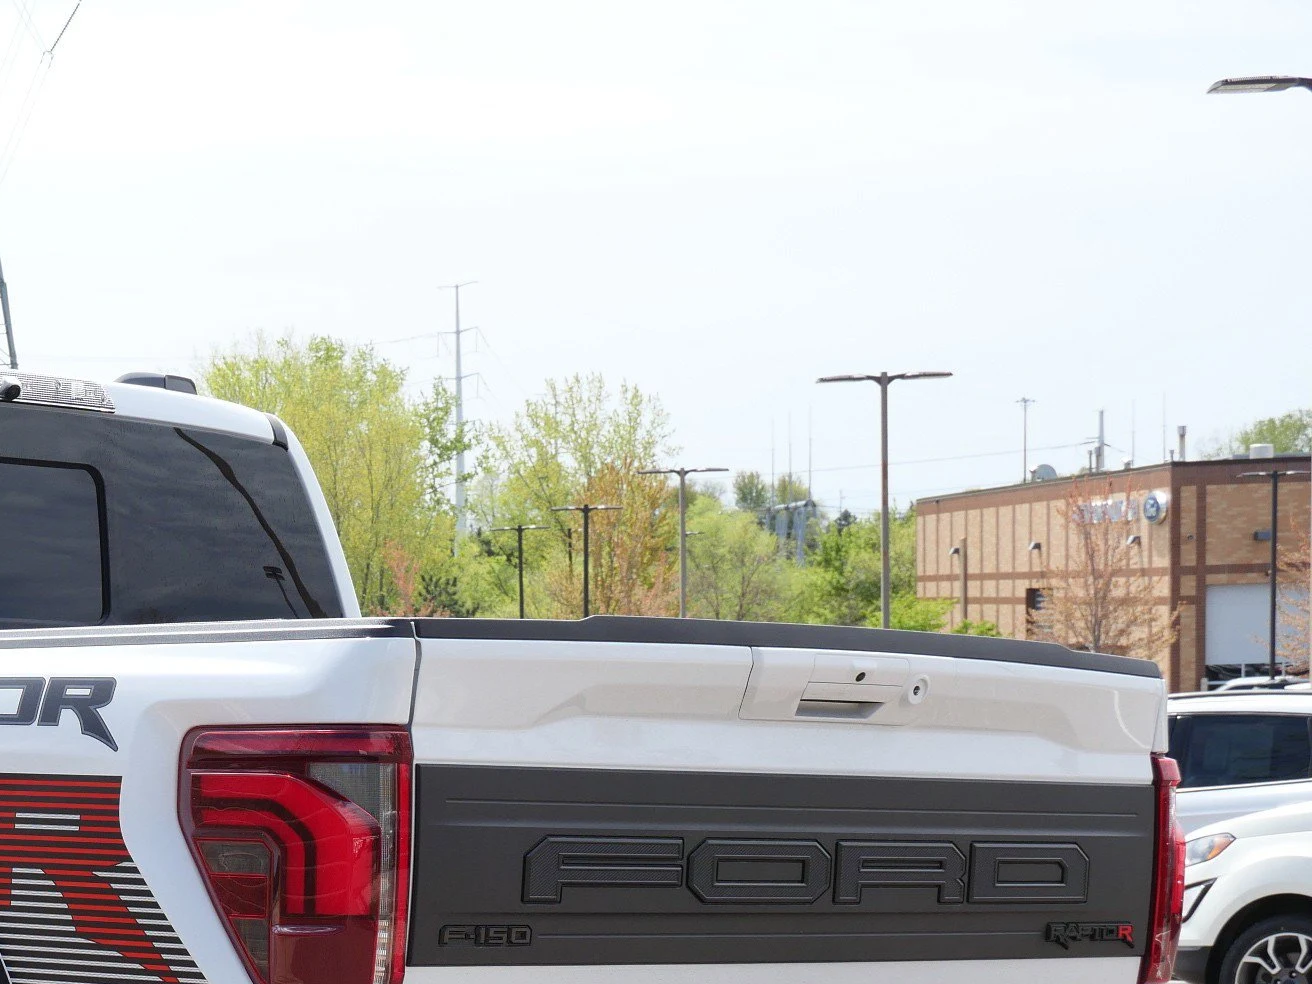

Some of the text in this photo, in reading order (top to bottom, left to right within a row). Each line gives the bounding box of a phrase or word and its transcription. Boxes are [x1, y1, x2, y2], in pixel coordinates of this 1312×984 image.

[521, 836, 1090, 904] FORD
[438, 924, 533, 947] F-150
[1045, 921, 1136, 950] RAPTOR
